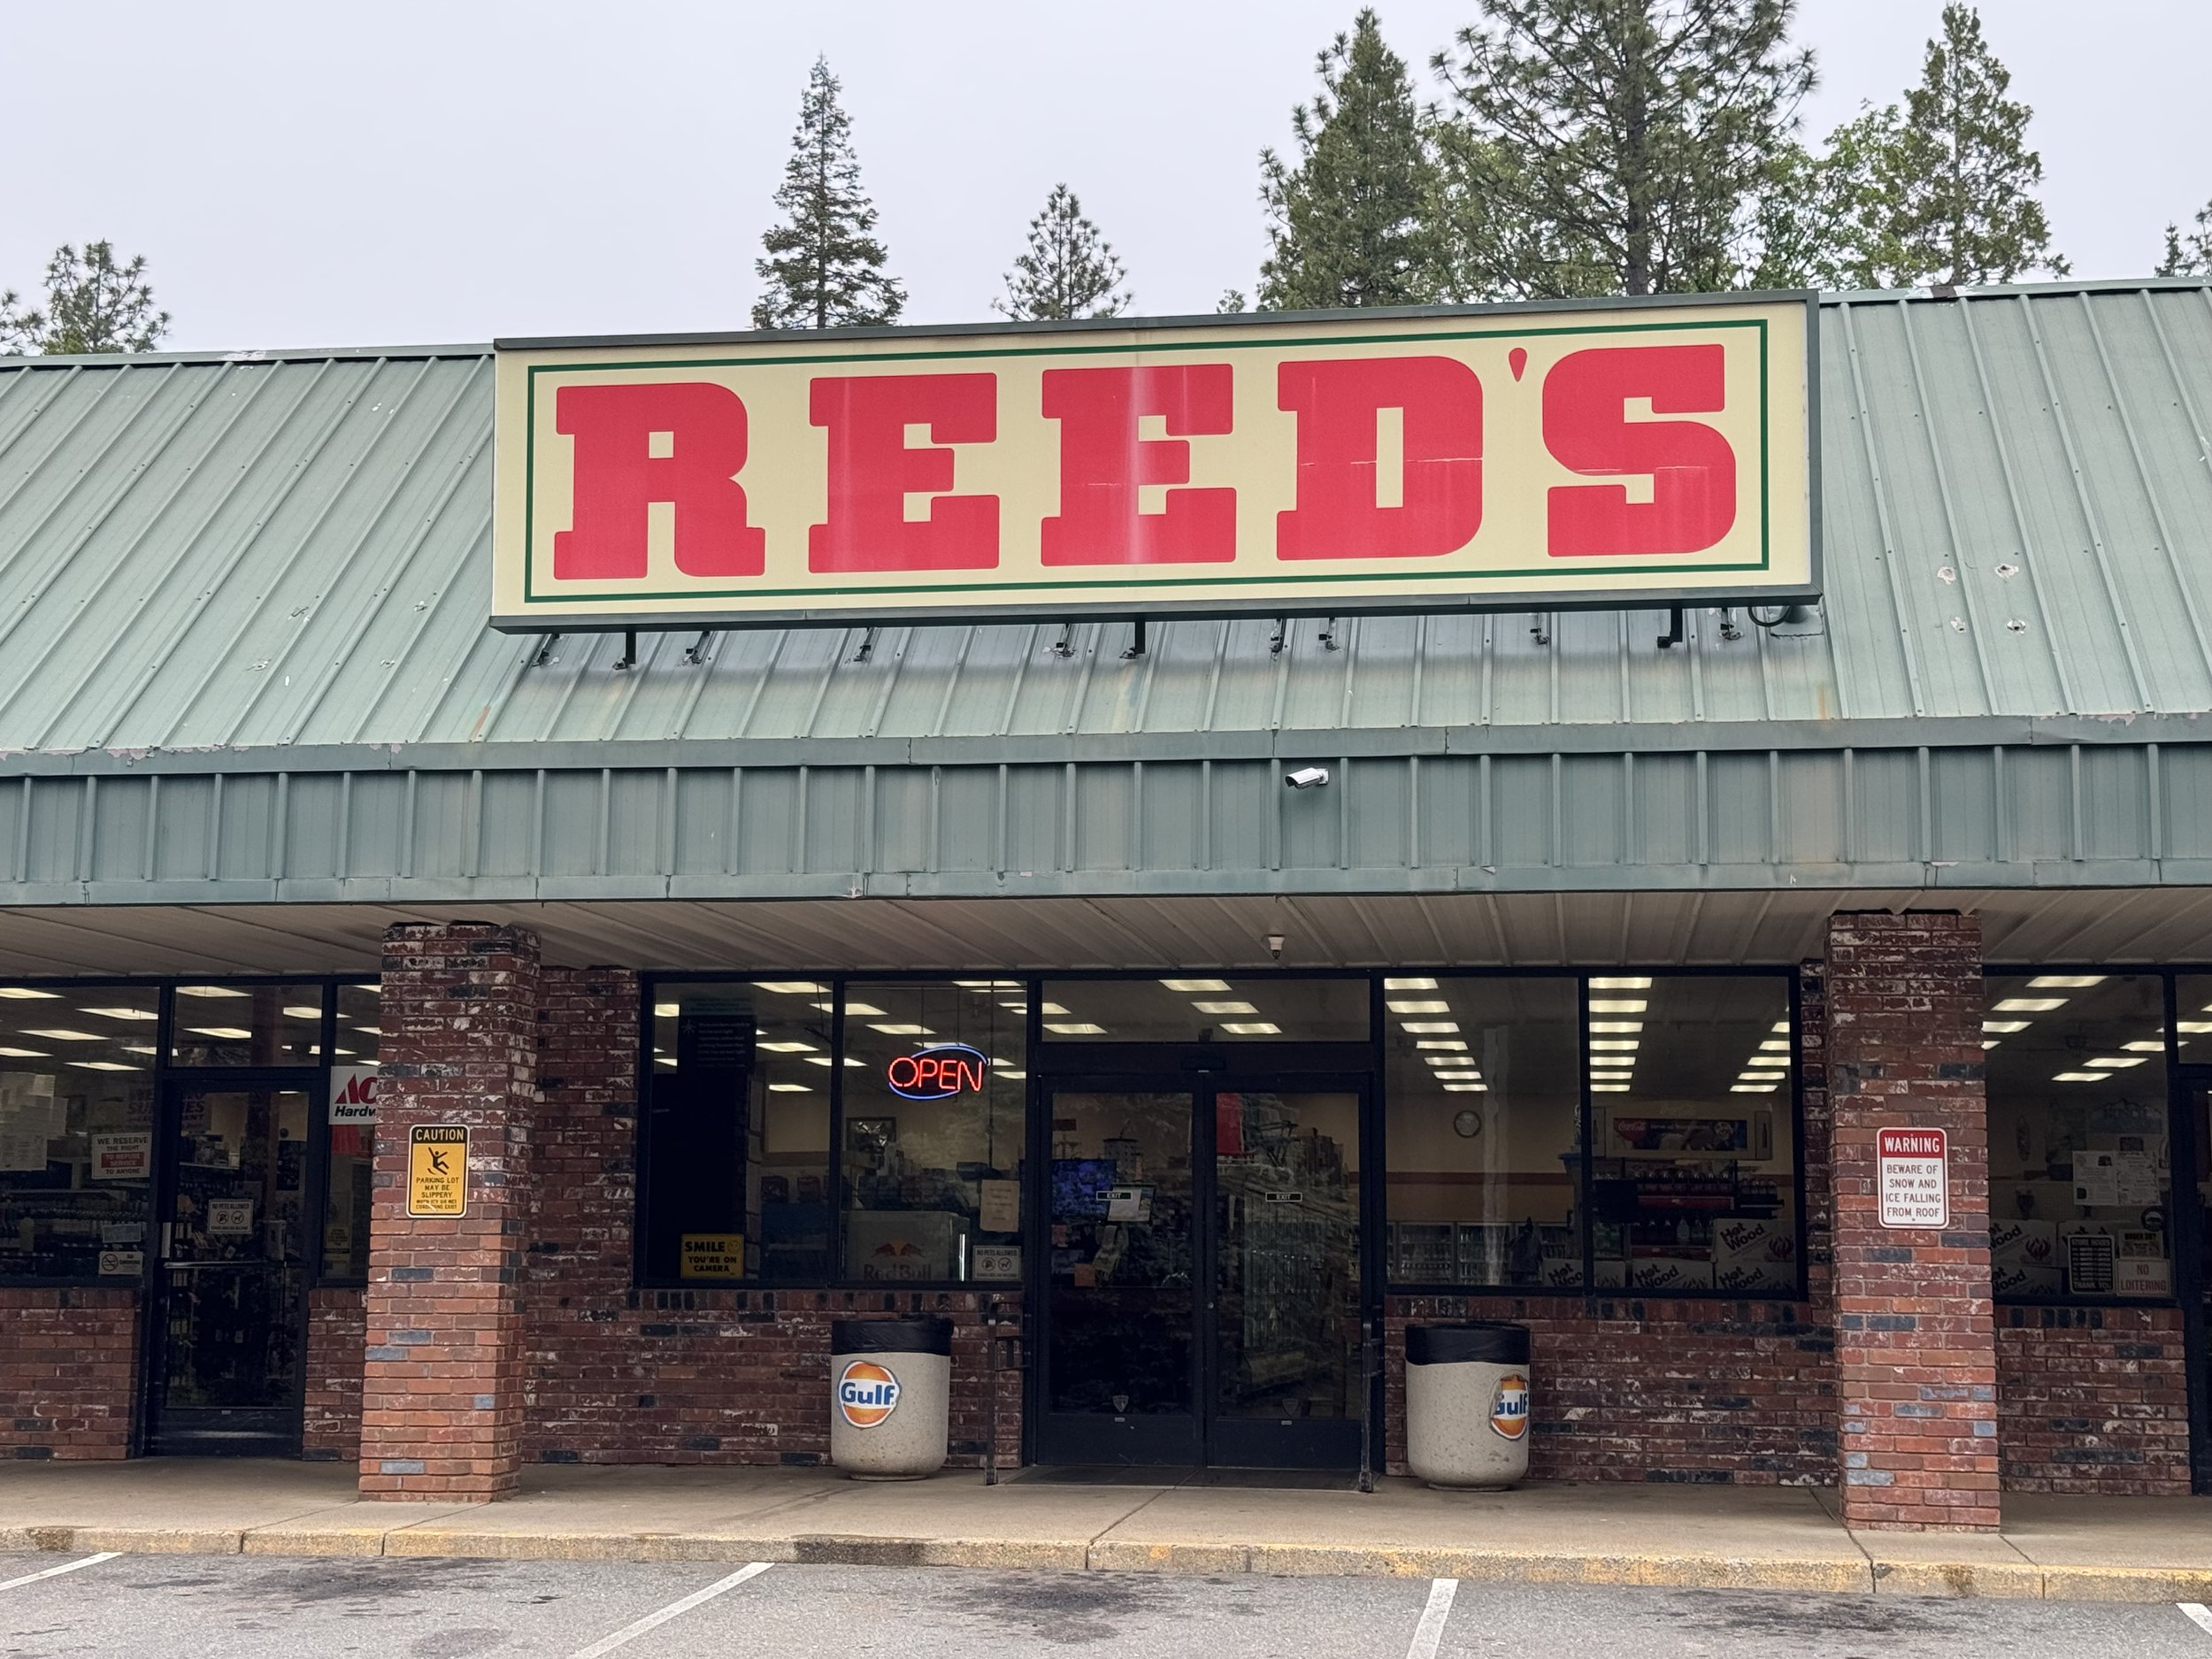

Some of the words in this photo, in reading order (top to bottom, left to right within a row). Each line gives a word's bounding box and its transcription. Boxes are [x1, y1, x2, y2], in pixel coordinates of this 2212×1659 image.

[553, 342, 1736, 580] REED'S
[888, 1056, 982, 1092] OPEN
[334, 1072, 378, 1104] AC
[334, 1106, 376, 1117] Hardw
[416, 1128, 465, 1141] CAUTION
[1884, 1137, 1940, 1153] WARNING
[1886, 1164, 1923, 1174] BEWARE
[1926, 1164, 1939, 1174] OF
[1889, 1179, 1915, 1188] SNOW
[1918, 1179, 1937, 1188] AND
[1886, 1193, 1900, 1202] ICE
[1903, 1193, 1941, 1203] FALLING
[1886, 1207, 1912, 1217] FROM
[1916, 1208, 1940, 1217] ROOF
[1720, 1222, 1747, 1241] Hot
[1725, 1224, 1766, 1251] Wood
[685, 1241, 726, 1253] SMILE
[1548, 1263, 1574, 1282] Hot
[1634, 1263, 1662, 1283] Hot
[1640, 1265, 1679, 1288] Wood
[1718, 1265, 1746, 1286] Hot
[2136, 1264, 2149, 1275] NO
[1554, 1271, 1582, 1286] Woo
[2120, 1279, 2167, 1291] LOITERING
[841, 1382, 895, 1405] Gulf
